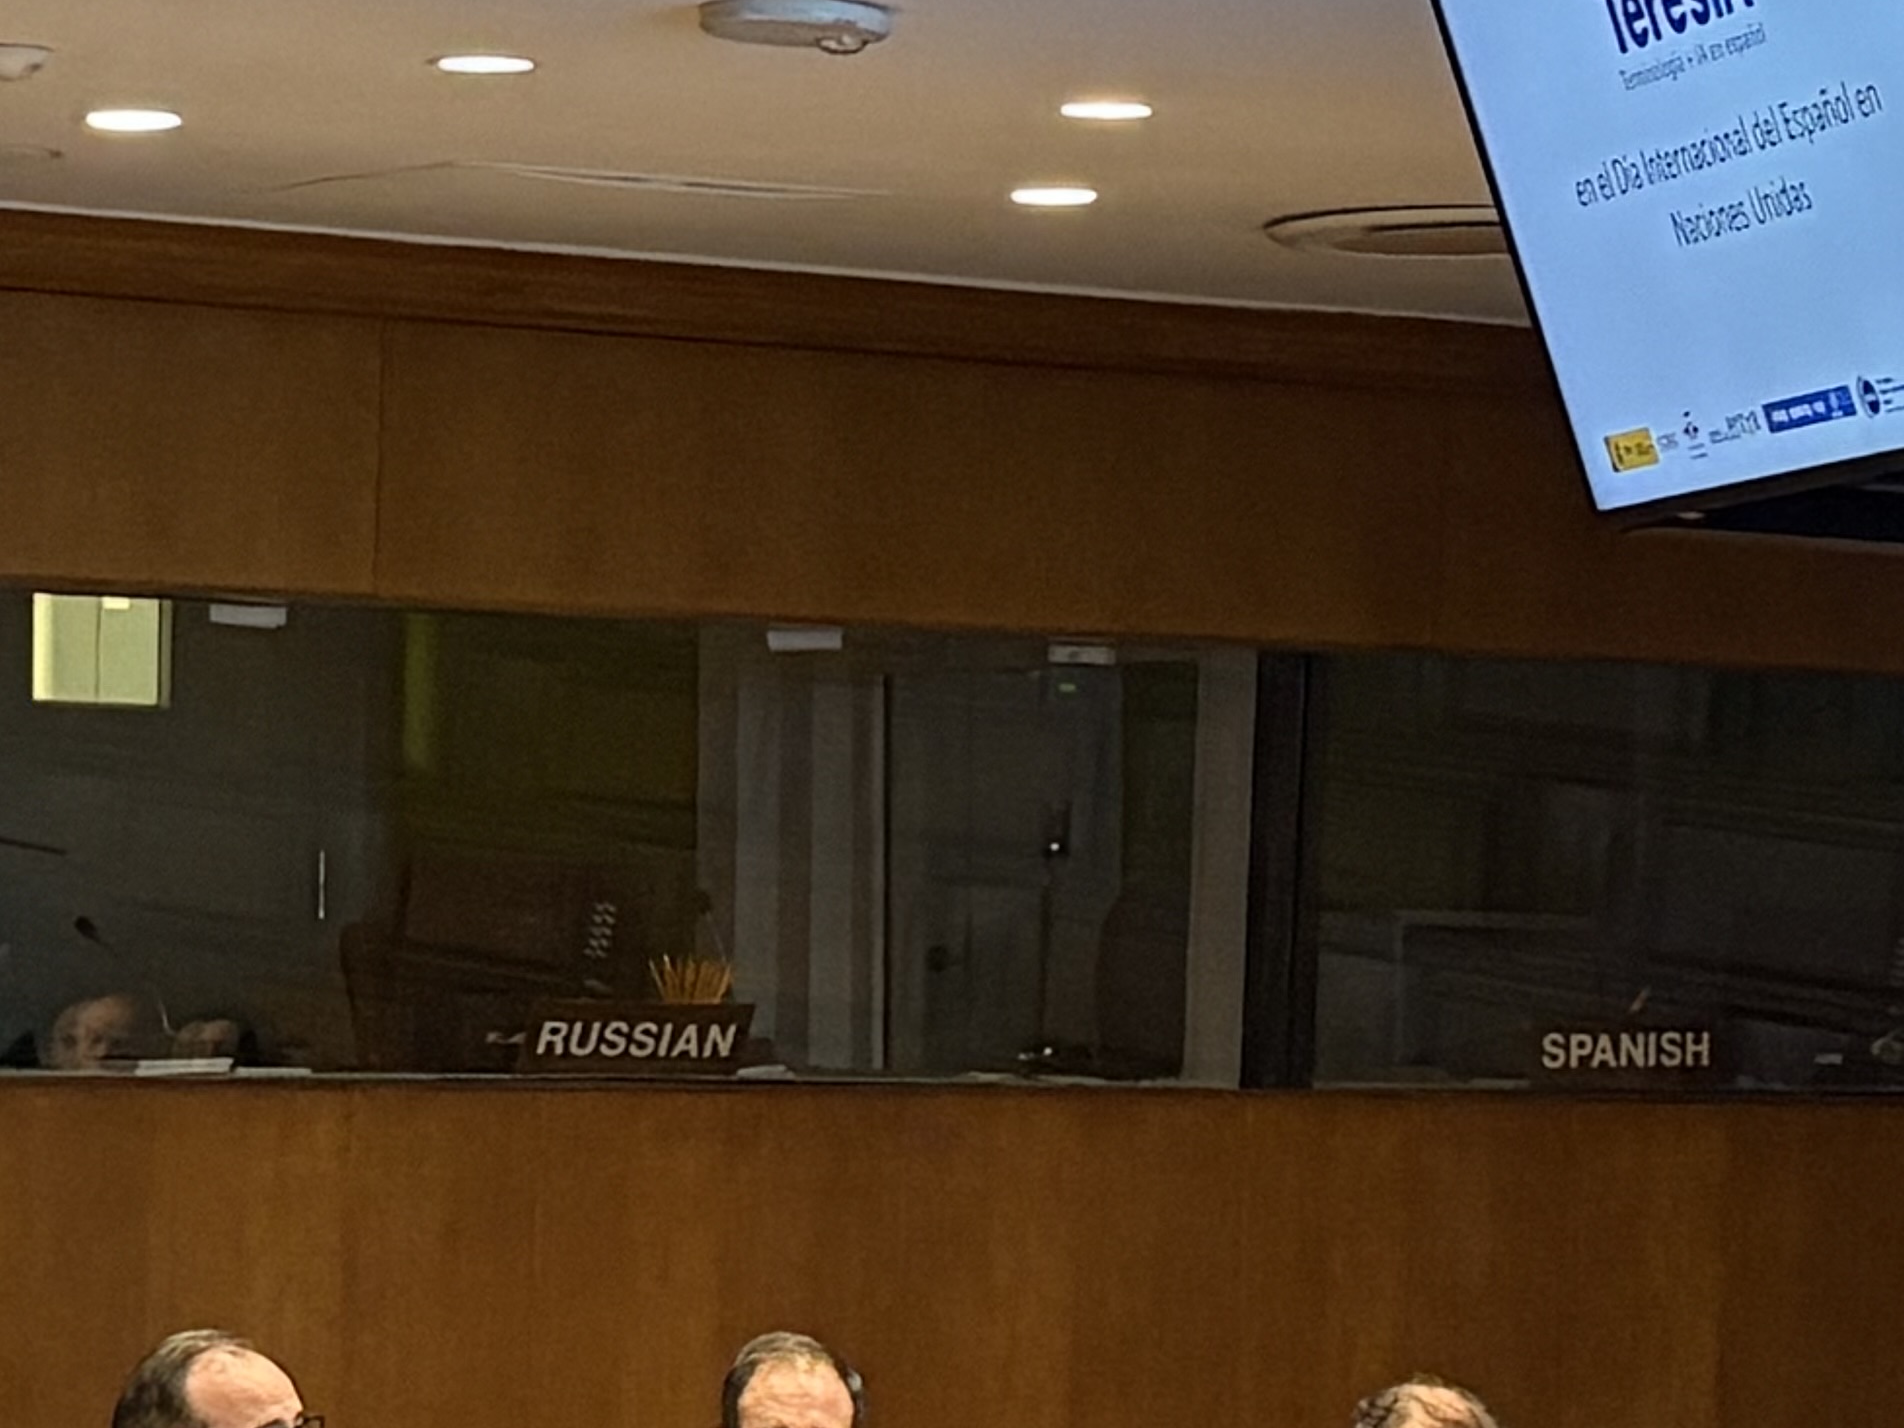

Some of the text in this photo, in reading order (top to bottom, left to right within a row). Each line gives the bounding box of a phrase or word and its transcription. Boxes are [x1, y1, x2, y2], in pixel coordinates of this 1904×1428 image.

[1576, 82, 1882, 206] en el Día Internacional del Español en
[1670, 175, 1812, 247] Naciones Unidas
[536, 1021, 736, 1057] RUSSIAN
[1542, 1031, 1710, 1068] SPANISH
